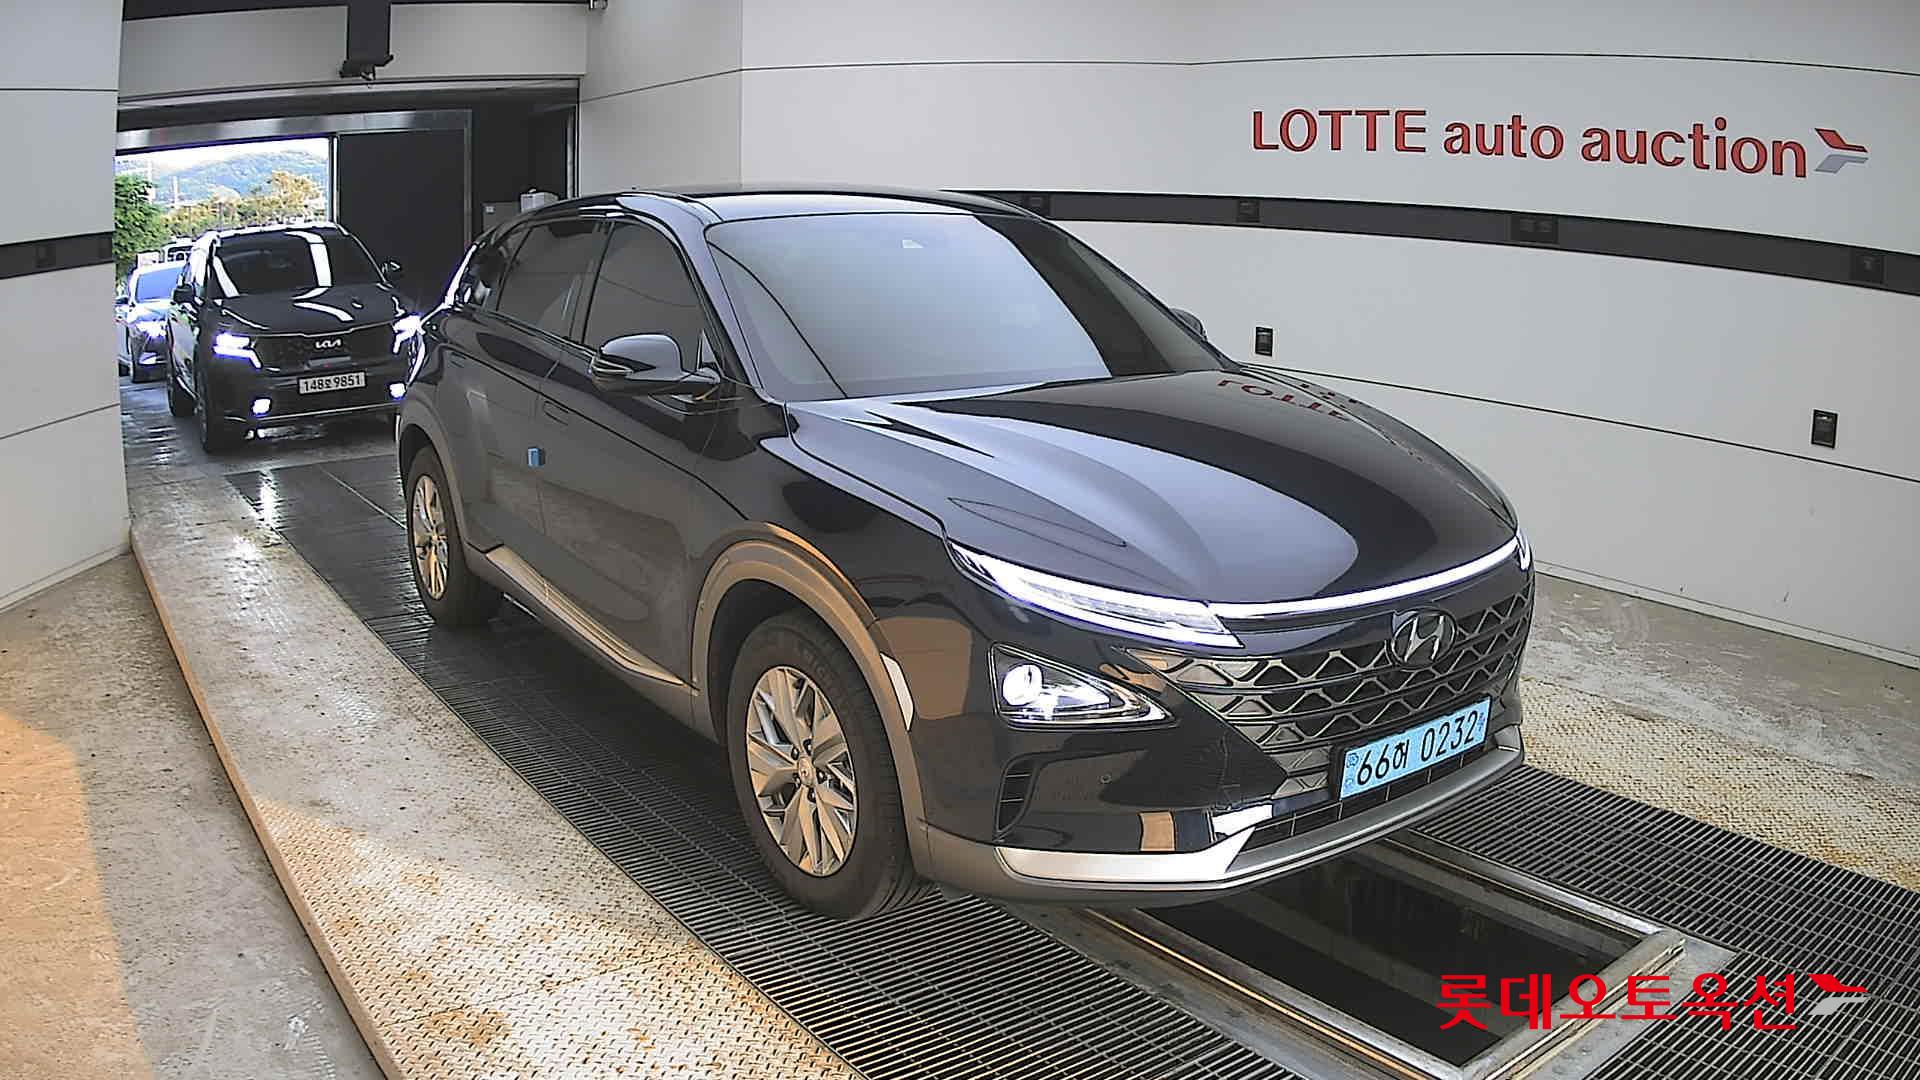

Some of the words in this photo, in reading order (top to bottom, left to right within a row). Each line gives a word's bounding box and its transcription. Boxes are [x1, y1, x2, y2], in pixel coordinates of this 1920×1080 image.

[1252, 108, 1427, 153] LOTTE
[1443, 114, 1564, 160] auto
[1580, 116, 1807, 179] auction
[333, 375, 361, 388] 9851
[1421, 710, 1478, 762] 0232
